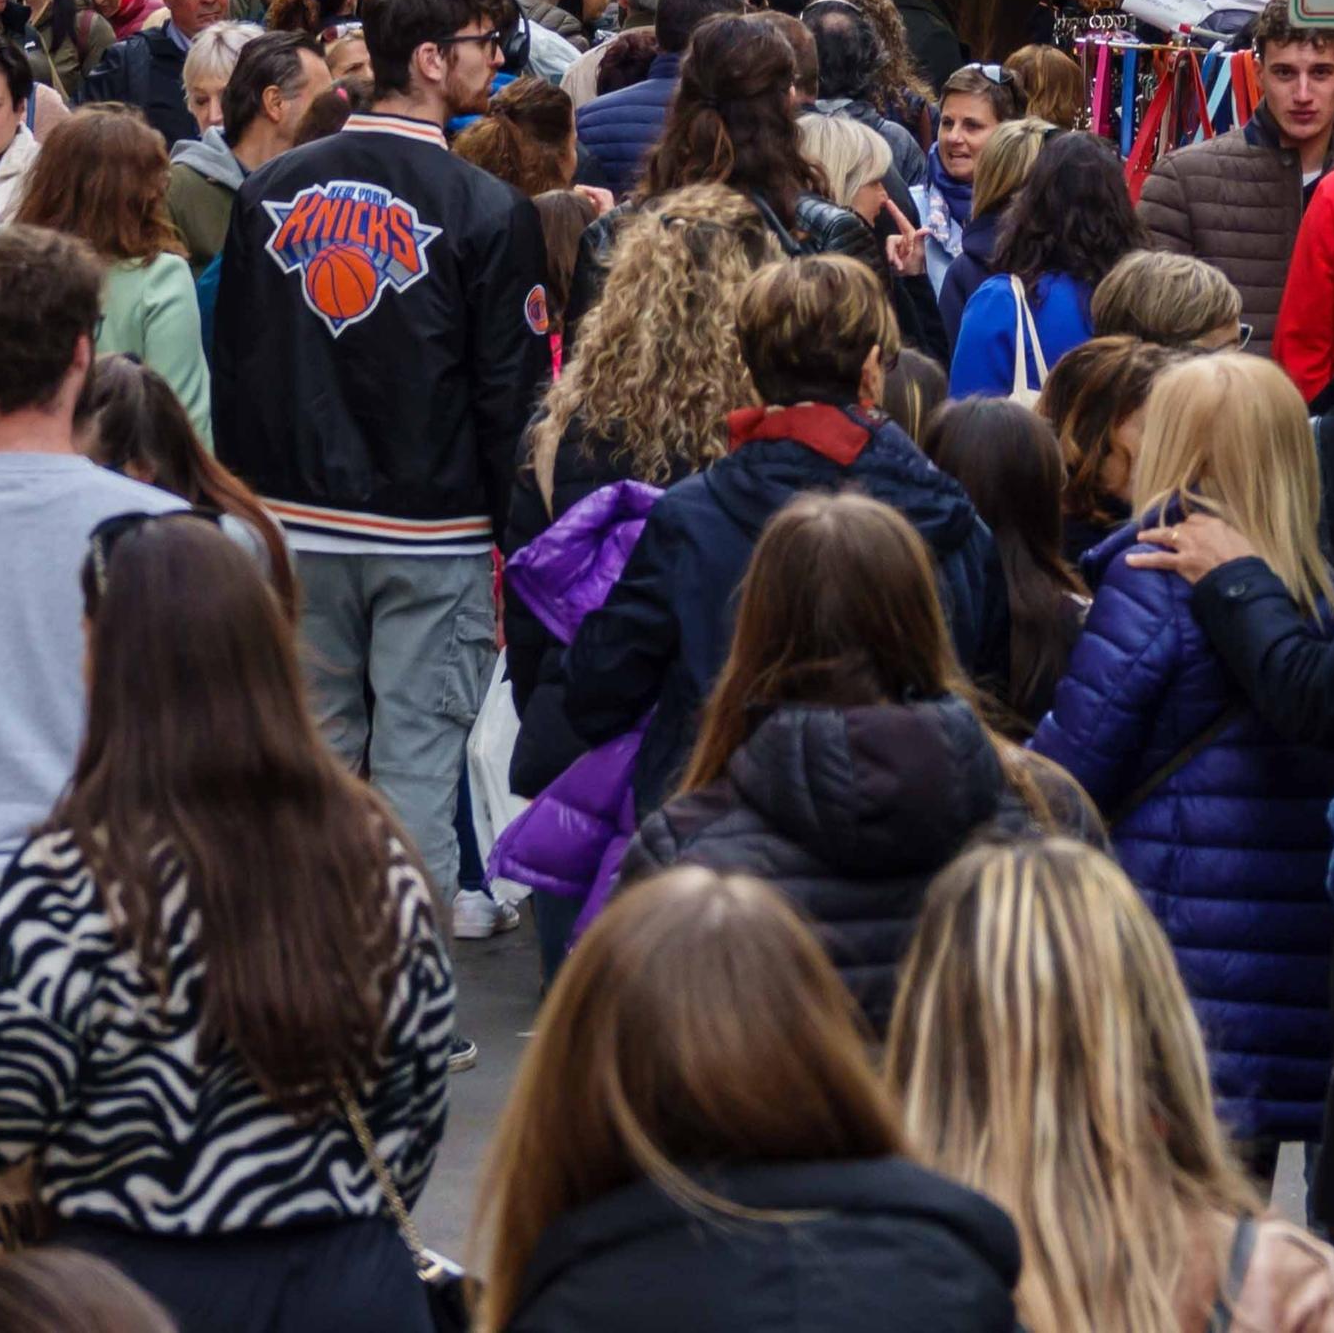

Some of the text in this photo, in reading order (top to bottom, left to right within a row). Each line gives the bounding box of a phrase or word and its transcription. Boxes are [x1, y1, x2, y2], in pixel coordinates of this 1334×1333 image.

[327, 186, 387, 207] NEW YORK
[272, 192, 420, 274] KNICKS
